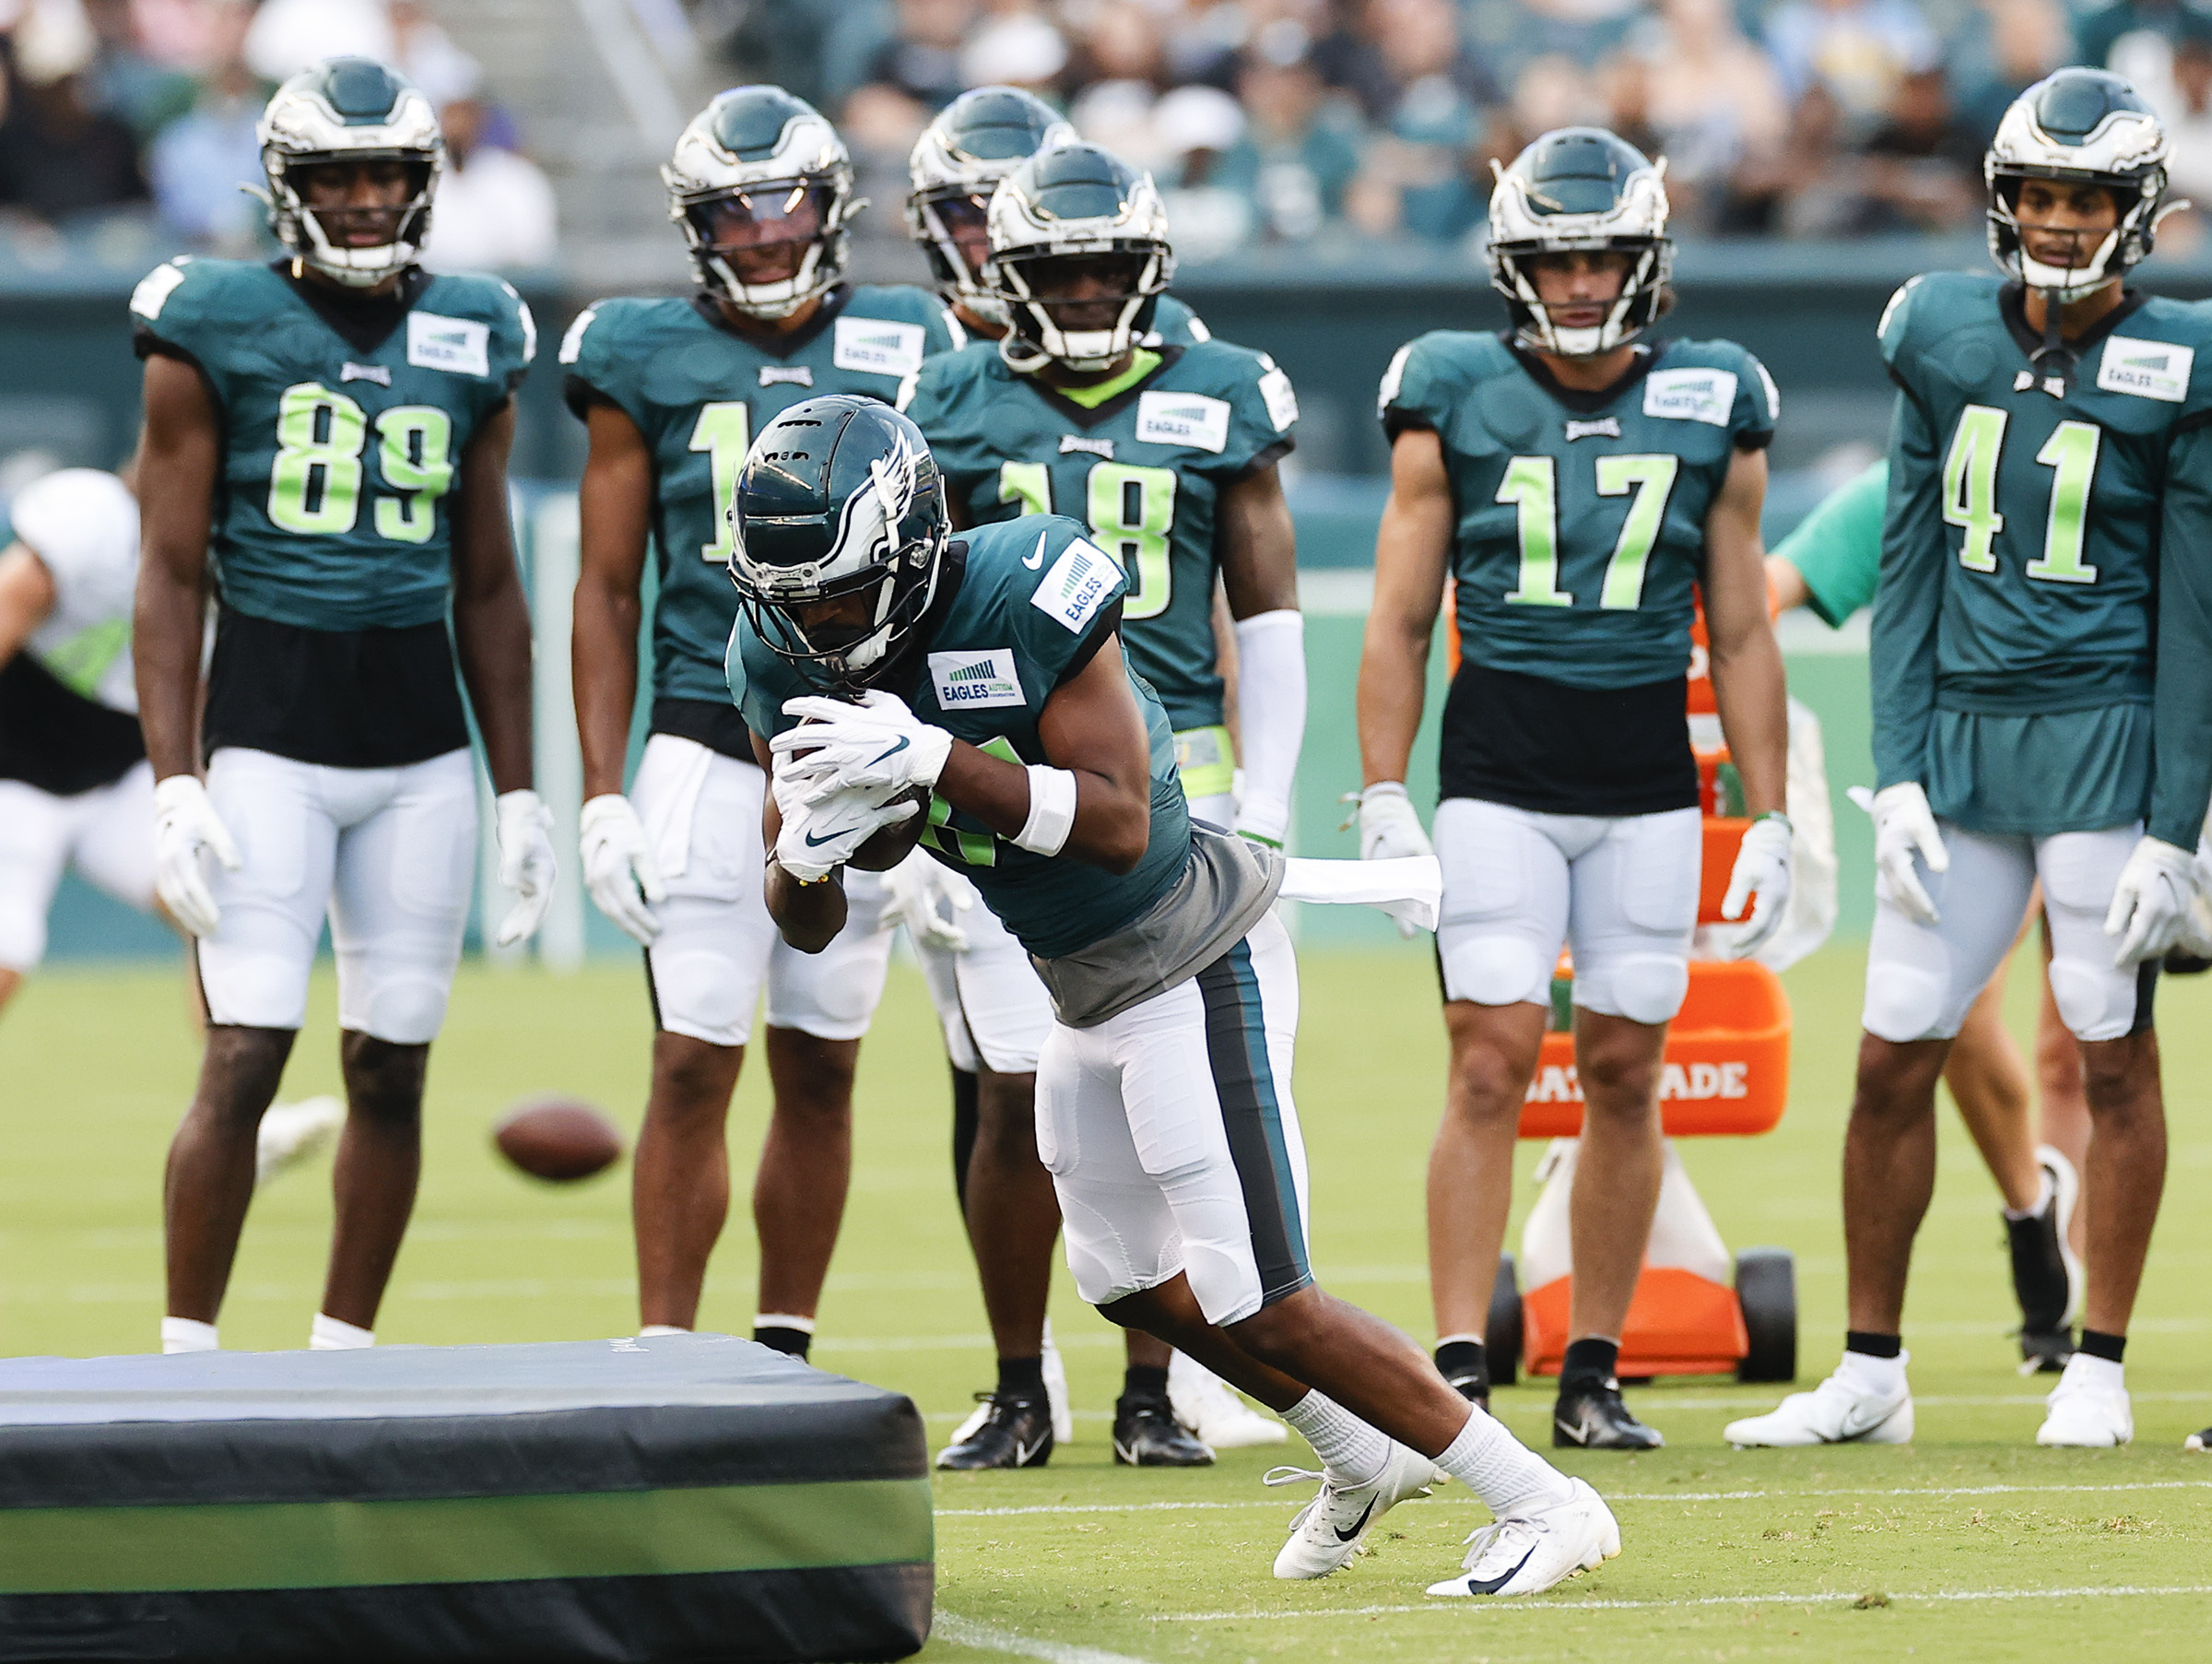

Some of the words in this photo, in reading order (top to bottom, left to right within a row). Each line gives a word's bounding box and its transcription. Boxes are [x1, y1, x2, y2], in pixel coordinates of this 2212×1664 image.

[267, 381, 453, 545] 89
[1942, 403, 2101, 584] 41
[1495, 454, 1678, 610] 17
[1065, 576, 1102, 621] EAGLES
[942, 683, 989, 702] EAGLES
[1524, 1062, 1748, 1103] AADE
